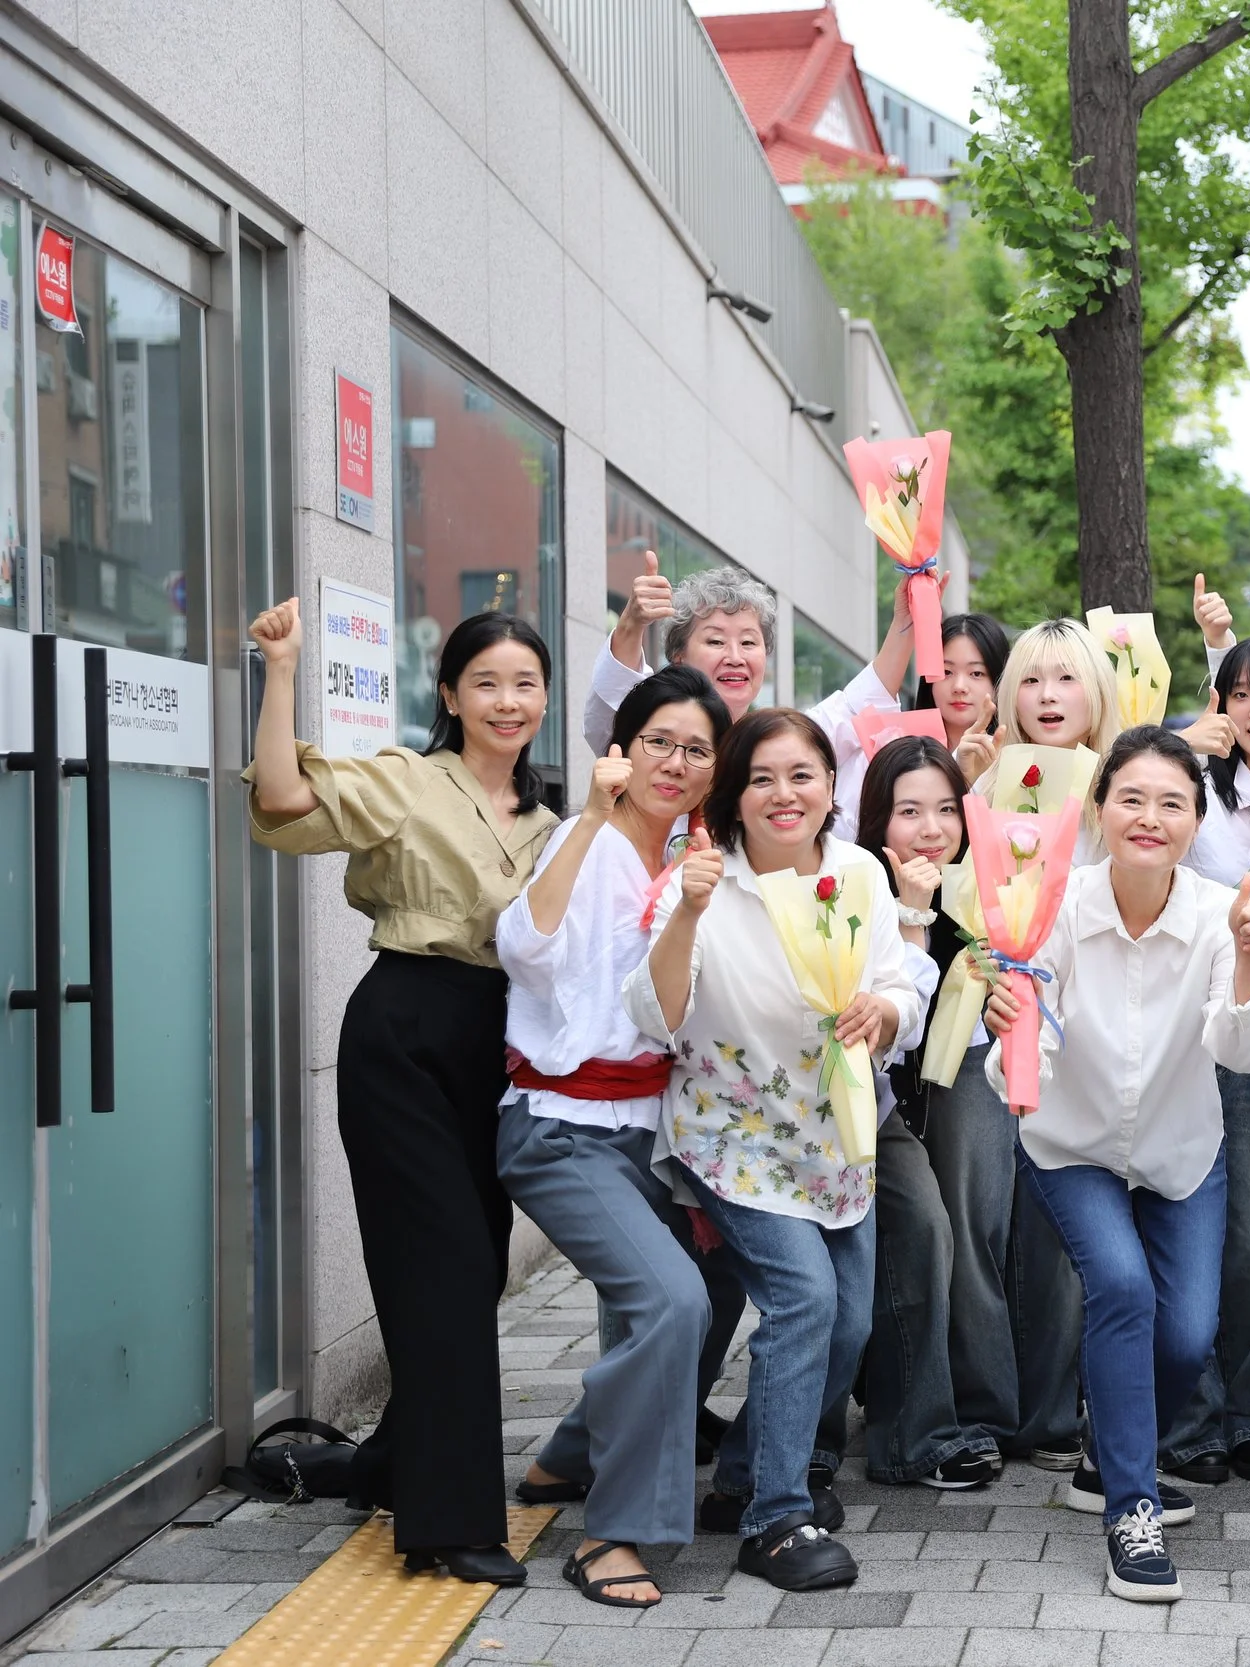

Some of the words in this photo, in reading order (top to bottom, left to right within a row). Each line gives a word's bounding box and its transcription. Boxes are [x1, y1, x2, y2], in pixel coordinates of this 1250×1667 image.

[41, 252, 67, 290] 에스원
[344, 417, 367, 461] 에스원
[328, 660, 344, 696] 쓰레기
[344, 664, 354, 699] 없는
[354, 667, 369, 702] 깨끗한
[369, 669, 380, 703] 마을
[132, 716, 148, 729] YOUTH
[149, 717, 178, 733] ASSOCIATION
